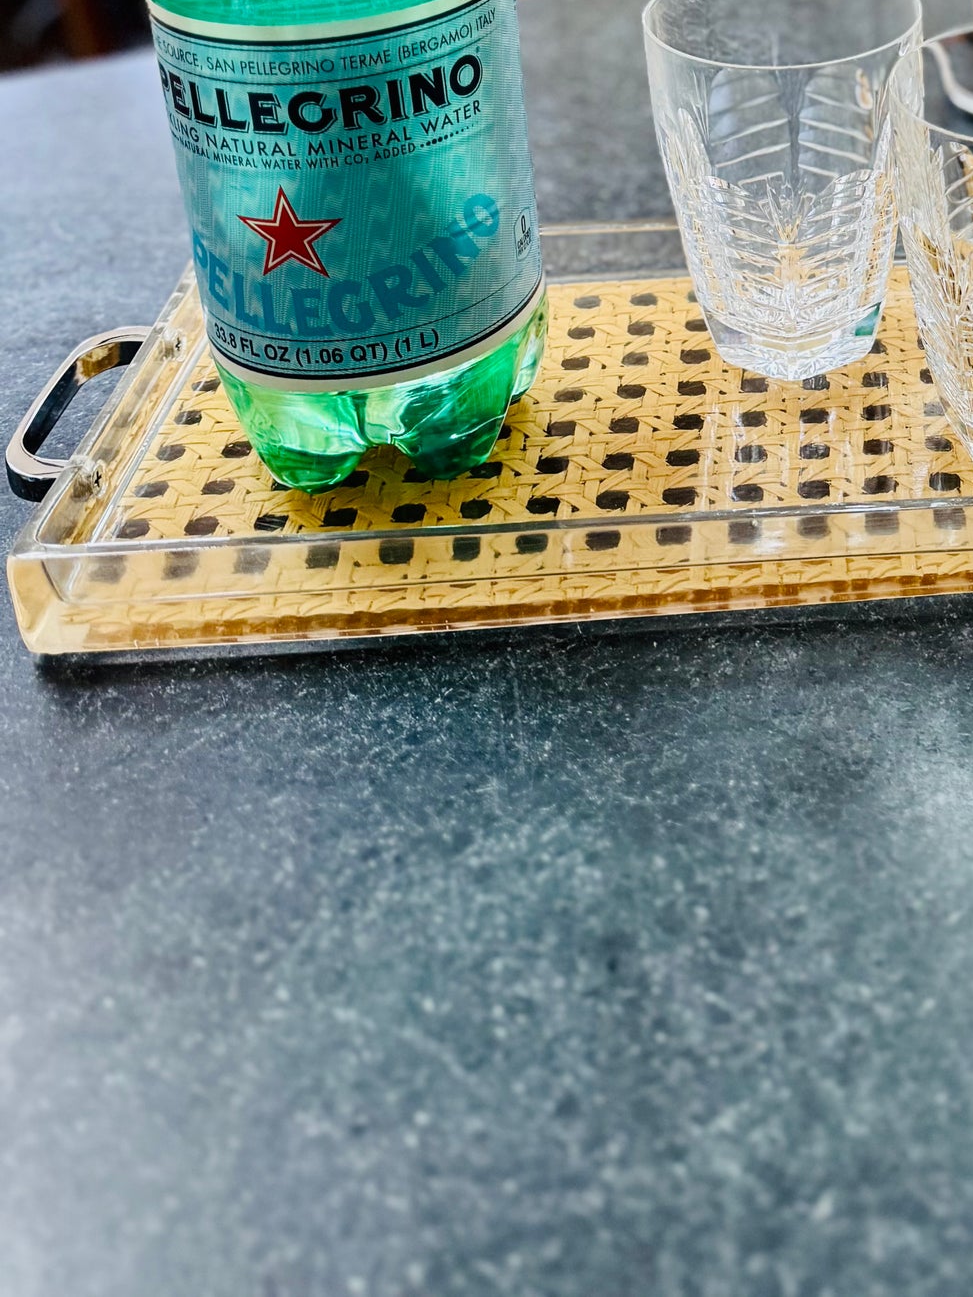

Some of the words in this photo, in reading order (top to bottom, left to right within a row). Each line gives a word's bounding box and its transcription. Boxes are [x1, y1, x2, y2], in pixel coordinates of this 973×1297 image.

[163, 39, 204, 70] SOURCE,
[206, 56, 236, 75] SAN
[240, 58, 335, 76] PELLEGRINO
[340, 48, 392, 71] TERME
[398, 22, 473, 64] (BERGAMO)
[475, 7, 497, 32] ITALY
[205, 132, 297, 157] NATURAL
[308, 126, 413, 157] MINERAL
[420, 99, 482, 135] WATER
[213, 150, 258, 169] MINERAL
[262, 157, 302, 170] WATER
[305, 157, 339, 170] WITH
[373, 142, 416, 162] ADDED
[214, 322, 237, 349] 33.8
[240, 337, 260, 358] FL
[264, 344, 291, 363] OZ
[295, 348, 344, 367] (1.06
[350, 342, 388, 364] QT)
[394, 337, 411, 358] (1
[420, 328, 440, 349] L)
